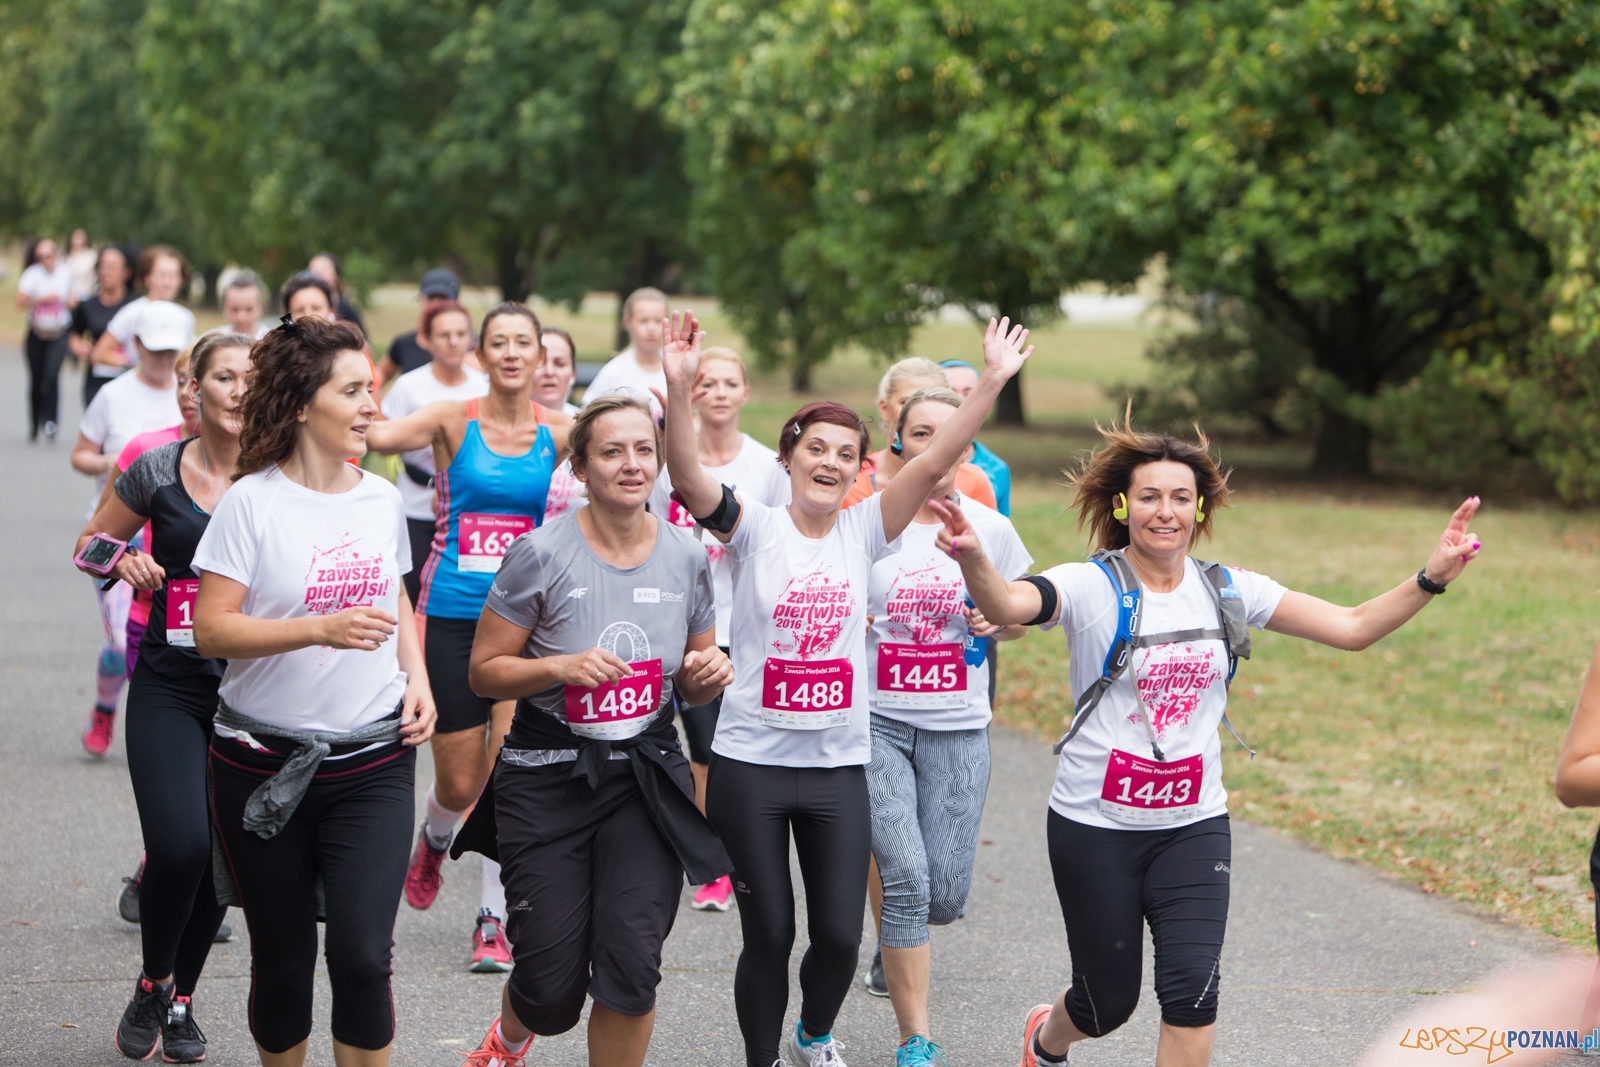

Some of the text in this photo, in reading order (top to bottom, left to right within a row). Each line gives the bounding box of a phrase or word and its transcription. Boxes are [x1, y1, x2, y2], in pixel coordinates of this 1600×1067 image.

[469, 531, 515, 555] 163
[317, 566, 380, 583] zawsze
[787, 591, 847, 604] zawsze
[896, 588, 957, 599] zawsze
[178, 600, 193, 626] 1
[307, 600, 334, 612] 2016
[776, 618, 802, 629] 2016
[888, 615, 911, 623] 2016
[805, 626, 833, 653] 15
[828, 666, 840, 674] 2016
[889, 664, 957, 689] 1445
[1148, 661, 1210, 677] zawsze
[579, 684, 654, 720] 1484
[774, 680, 844, 709] 1488
[1131, 763, 1153, 774] Zawsze
[1177, 765, 1190, 773] 2016
[1116, 776, 1192, 805] 1443
